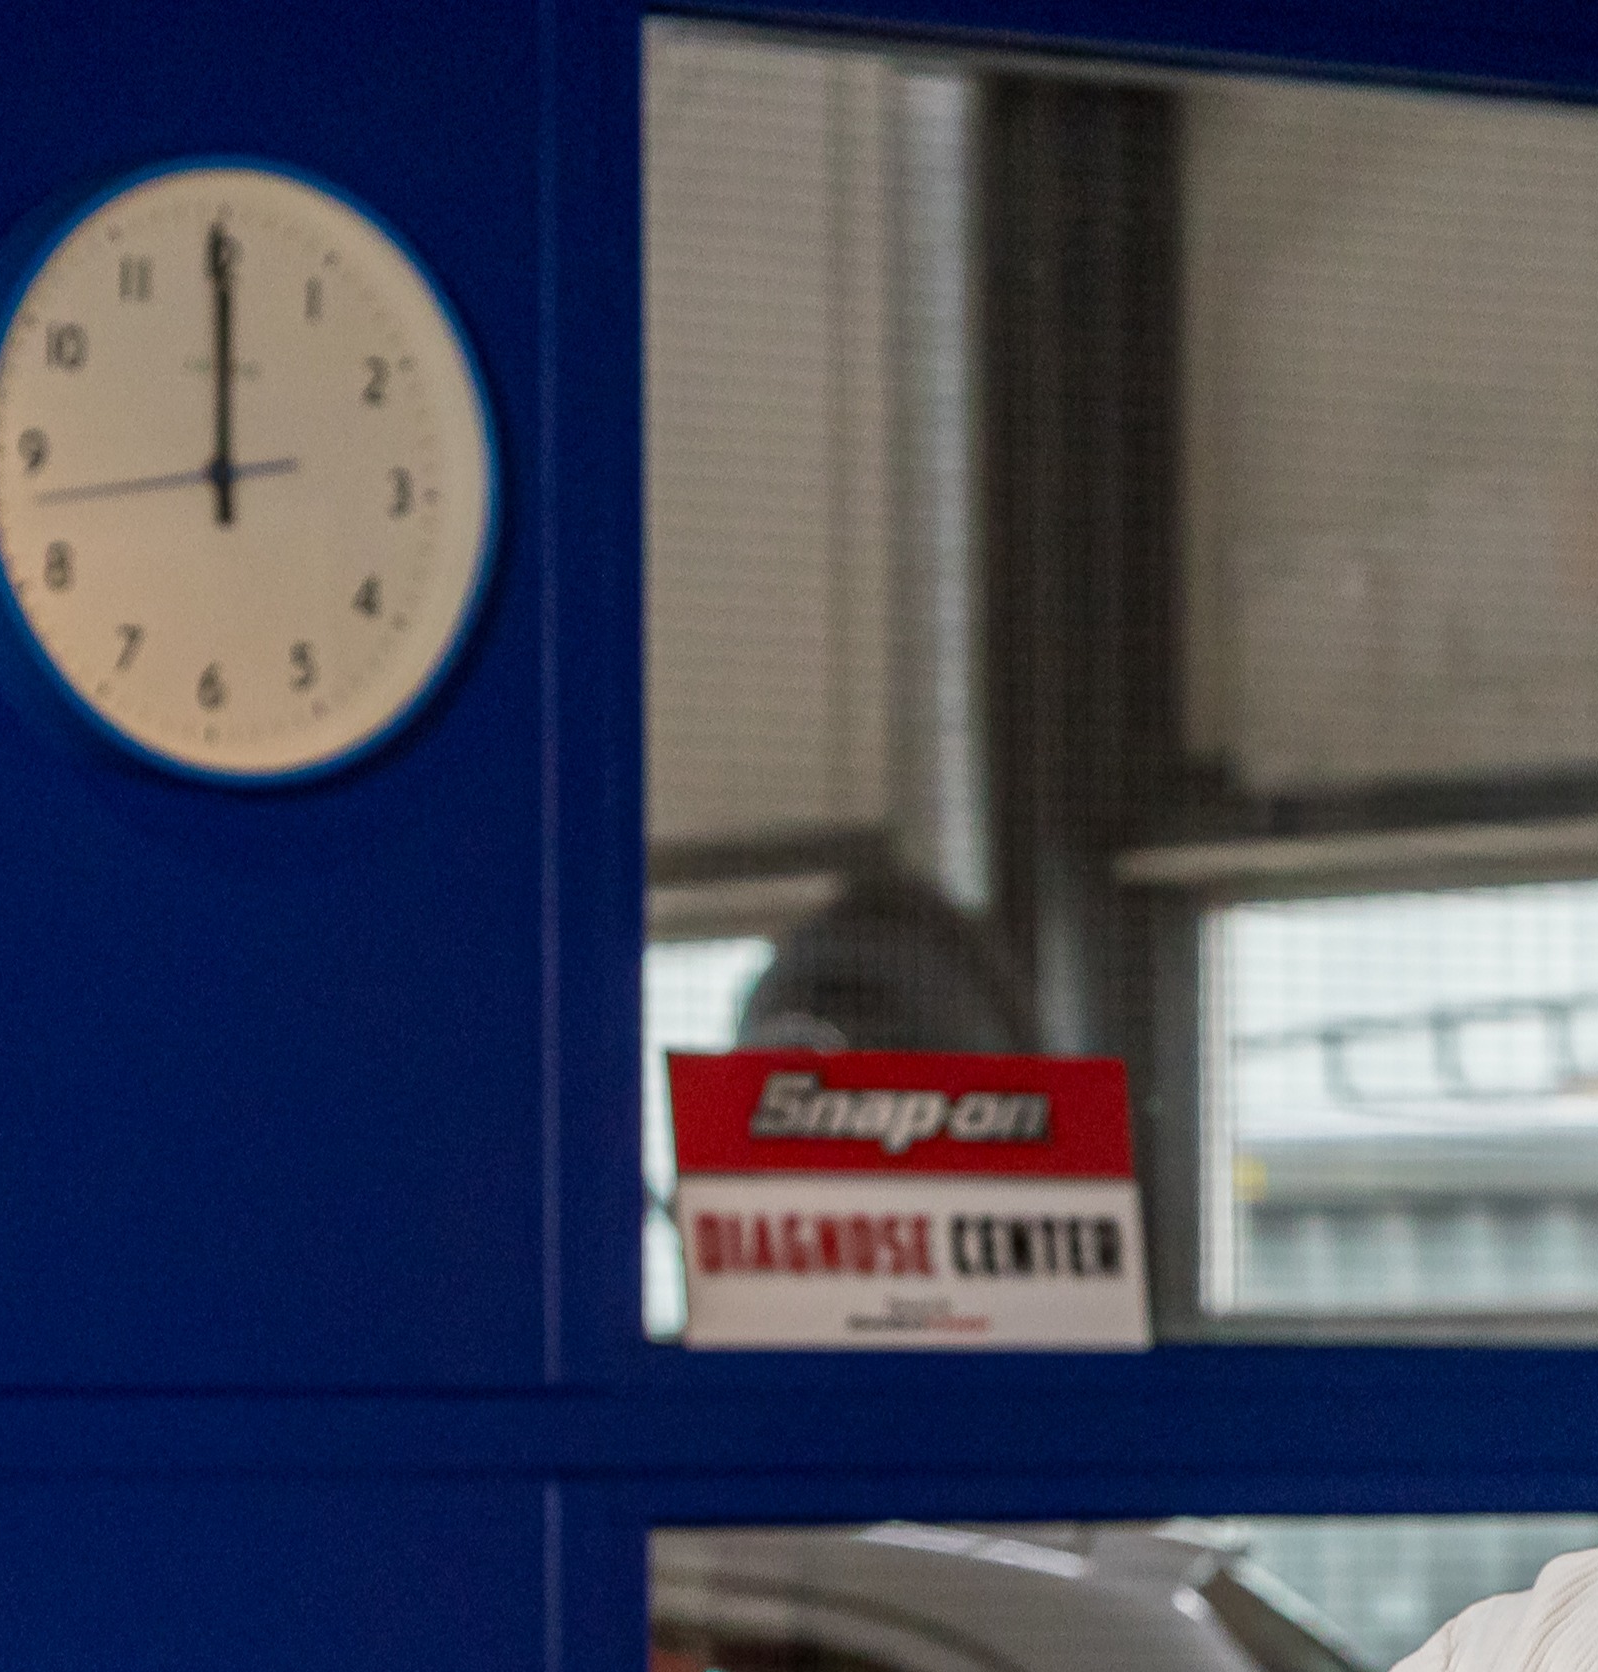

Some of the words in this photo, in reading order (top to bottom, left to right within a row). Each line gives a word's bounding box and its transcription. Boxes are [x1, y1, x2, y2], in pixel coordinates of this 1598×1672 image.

[44, 321, 90, 373] 10
[361, 355, 392, 407] 2
[18, 426, 50, 476] 9
[389, 467, 414, 519] 3
[44, 538, 74, 593] 8
[351, 574, 384, 619] 4
[115, 623, 145, 672] 7
[290, 640, 320, 691] 5
[197, 661, 226, 711] 6
[695, 1212, 937, 1277] DIAGNOSE
[949, 1214, 1123, 1279] CENTER
